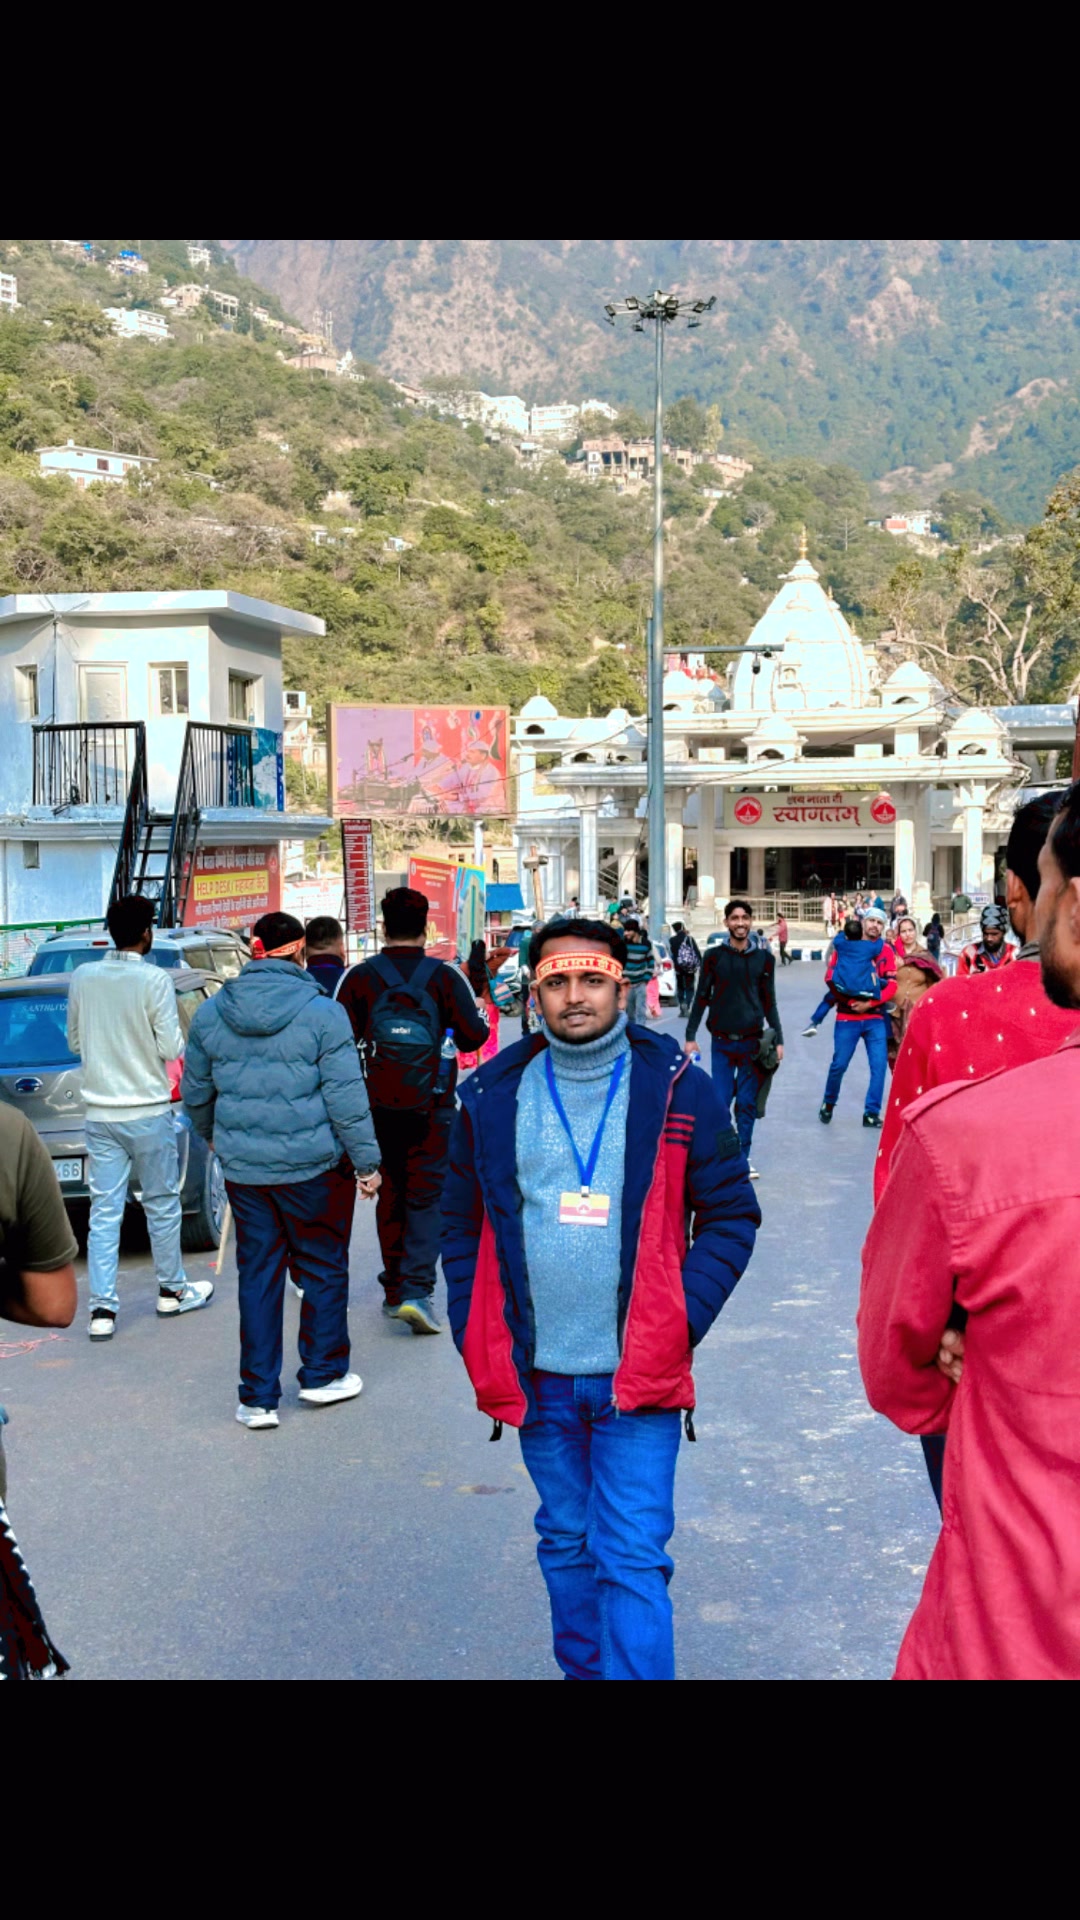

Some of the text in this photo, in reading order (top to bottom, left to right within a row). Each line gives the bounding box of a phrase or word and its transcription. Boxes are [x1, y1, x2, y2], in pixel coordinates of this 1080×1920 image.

[806, 795, 830, 805] माता
[773, 806, 861, 826] स्वागतम्
[197, 882, 213, 896] HELP
[215, 880, 230, 894] DESK
[556, 957, 595, 968] माता
